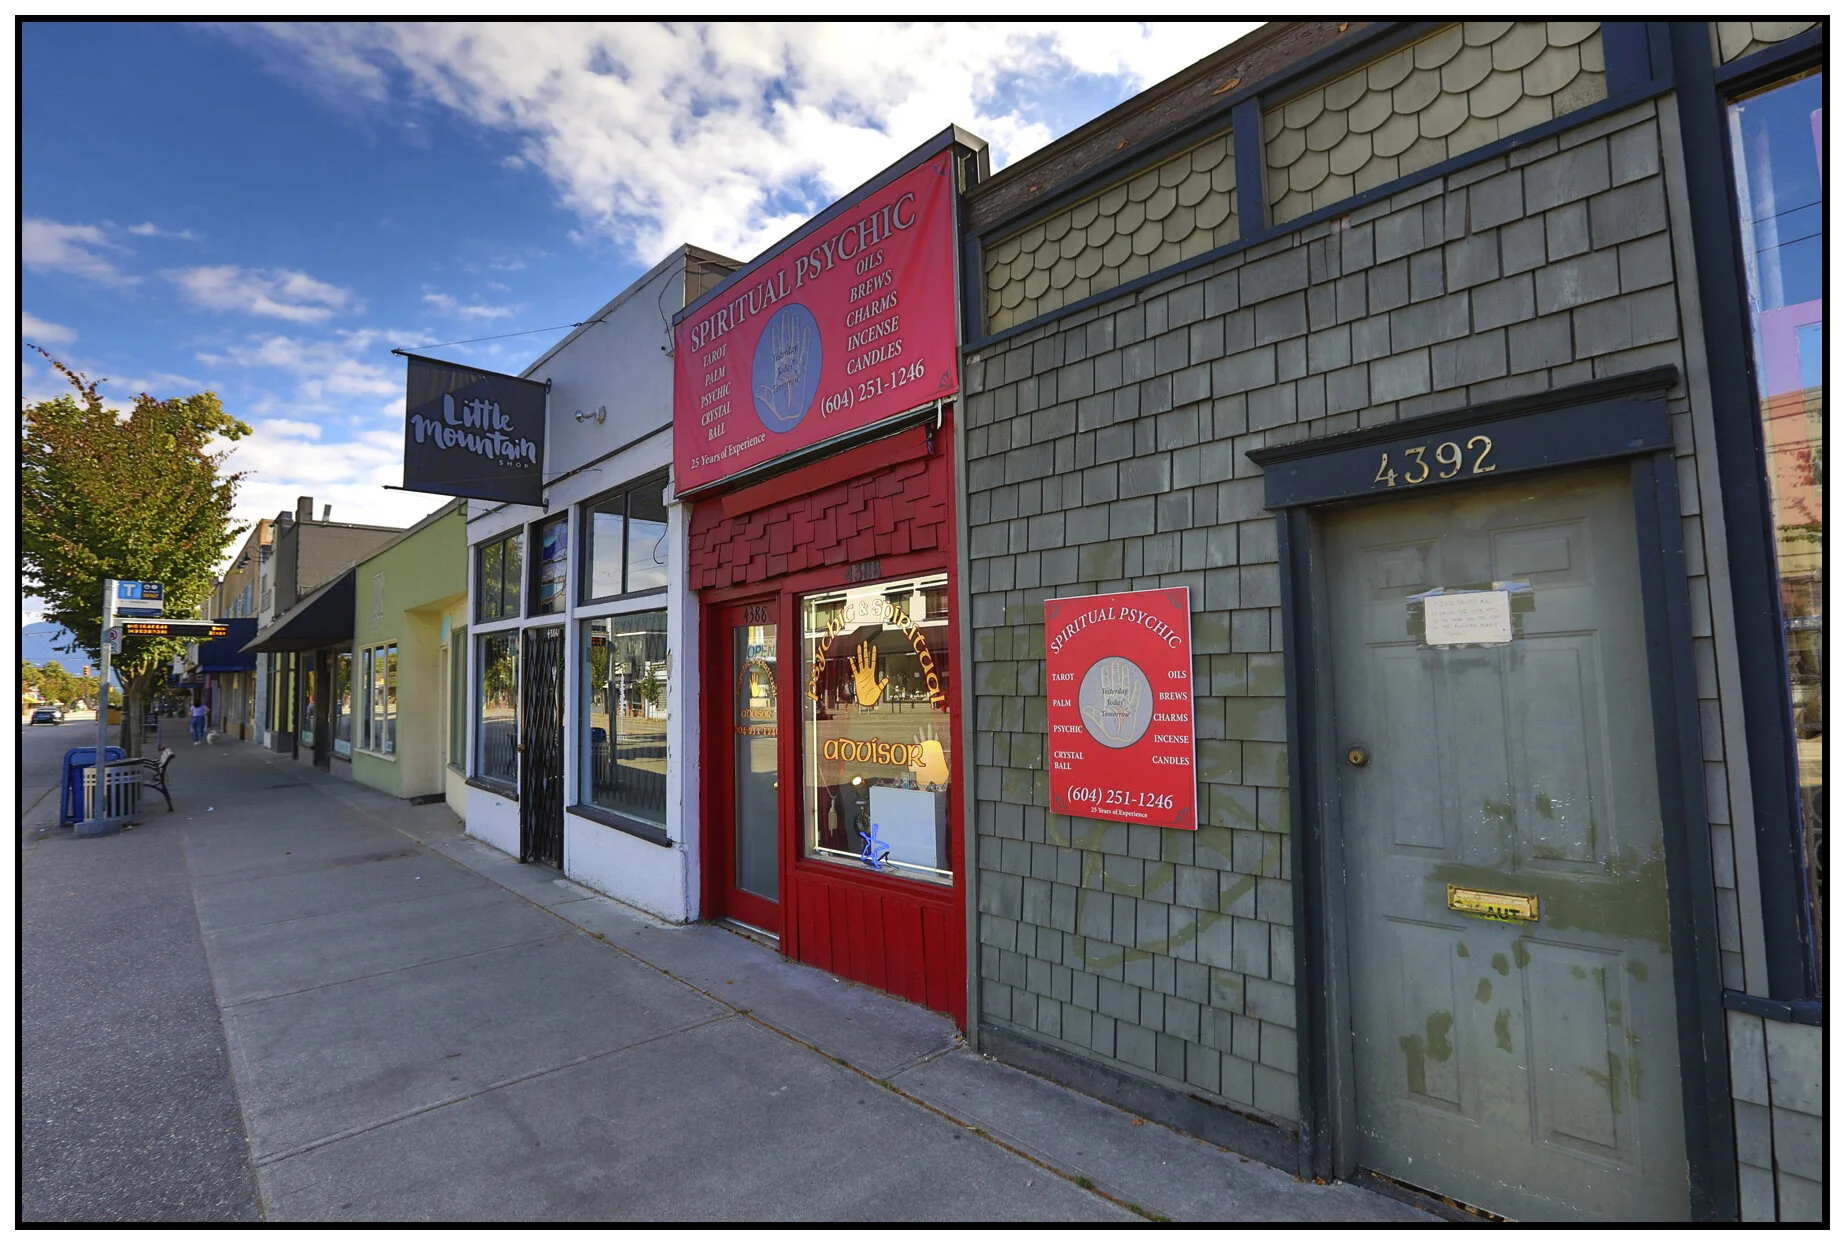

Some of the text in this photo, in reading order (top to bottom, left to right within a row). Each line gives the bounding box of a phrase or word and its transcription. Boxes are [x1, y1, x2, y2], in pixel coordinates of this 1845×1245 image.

[856, 249, 884, 276] OILS
[690, 192, 916, 353] SPIRITUAL PSYCHIC
[849, 269, 892, 304] BREWS
[846, 290, 898, 329] CHARMS
[847, 316, 900, 352] INCENSE
[702, 343, 727, 368] TAROT
[846, 339, 902, 376] CANDLES
[705, 364, 726, 387] PALM
[700, 381, 732, 409] PSYCHIC
[820, 359, 926, 420] (604) 251-1246
[443, 393, 515, 432] Little
[701, 400, 732, 426] CRYSTAL
[410, 413, 537, 465] Mountain
[708, 422, 726, 441] BALL
[690, 432, 766, 469] 25 Years of Experience
[499, 459, 530, 469] SHOP
[1374, 435, 1496, 487] 4392
[845, 560, 882, 582] 4388
[123, 583, 137, 597] T
[743, 605, 767, 623] 4388
[1050, 607, 1182, 655] SPIRITUAL PSYCHIC
[747, 644, 776, 658] OPEN
[1052, 672, 1075, 681] TAROT
[1167, 670, 1187, 679] OILS
[1101, 687, 1129, 696] Yesterday
[1159, 691, 1188, 701] BREWS
[1052, 699, 1072, 707] PALM
[1106, 699, 1123, 707] Today
[1101, 710, 1131, 718] Tomorrow
[1153, 712, 1188, 722] CHARMS
[1053, 724, 1083, 733] PSYCHIC
[1153, 734, 1189, 744] INCENSE
[1054, 751, 1085, 760] CRYSTAL
[1152, 755, 1190, 766] CANDLES
[1054, 762, 1072, 770] BALL
[1067, 785, 1174, 809] (604) 251-1246
[1097, 806, 1111, 814] Years
[1118, 809, 1148, 819] Experience
